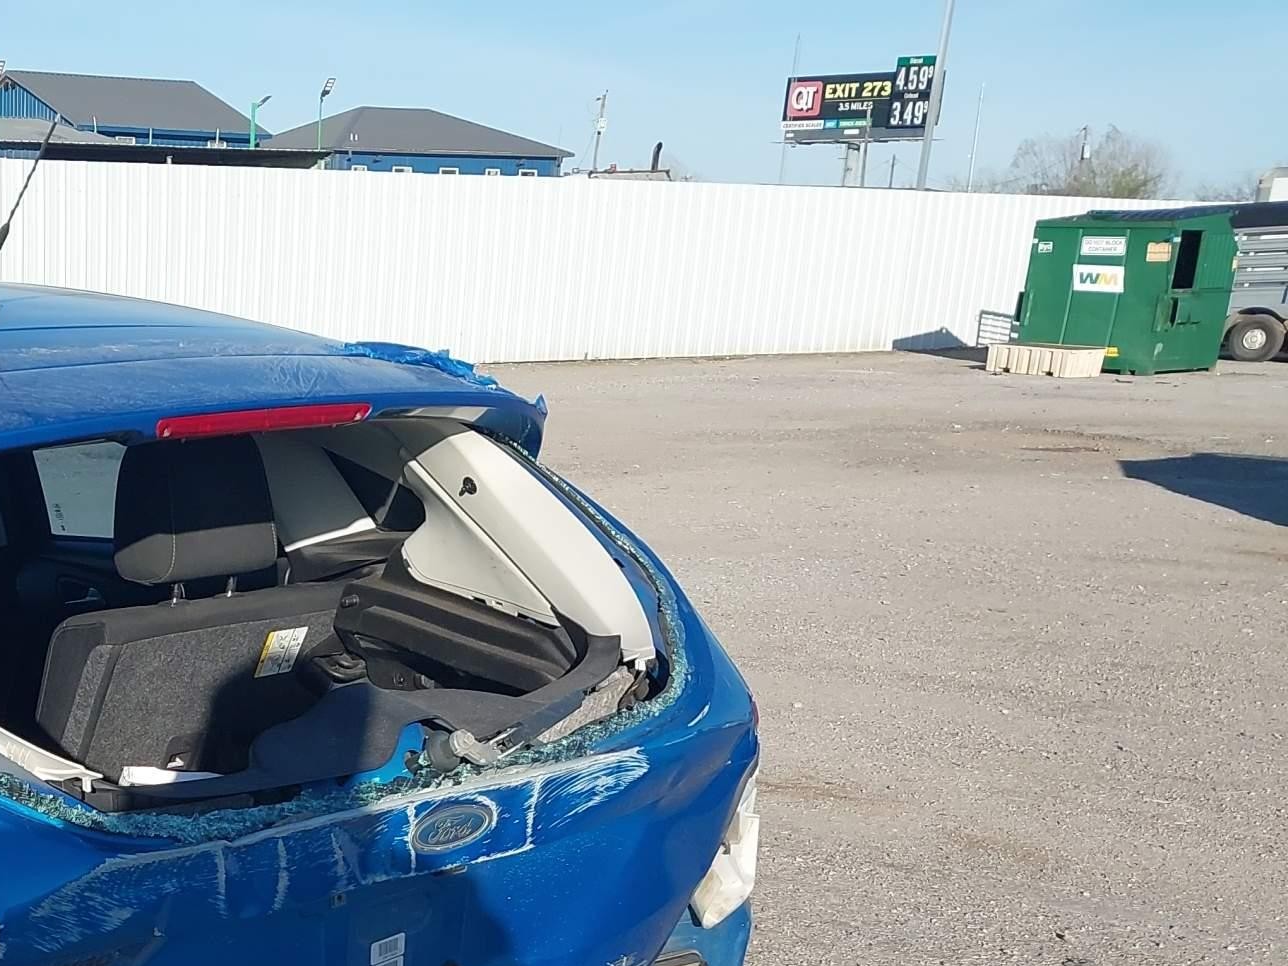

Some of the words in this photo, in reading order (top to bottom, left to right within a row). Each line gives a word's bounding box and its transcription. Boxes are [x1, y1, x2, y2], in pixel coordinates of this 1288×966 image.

[792, 86, 818, 112] QT
[824, 83, 860, 99] EXIT
[862, 81, 893, 97] 273
[1079, 272, 1119, 286] WM
[427, 814, 475, 845] Ford
